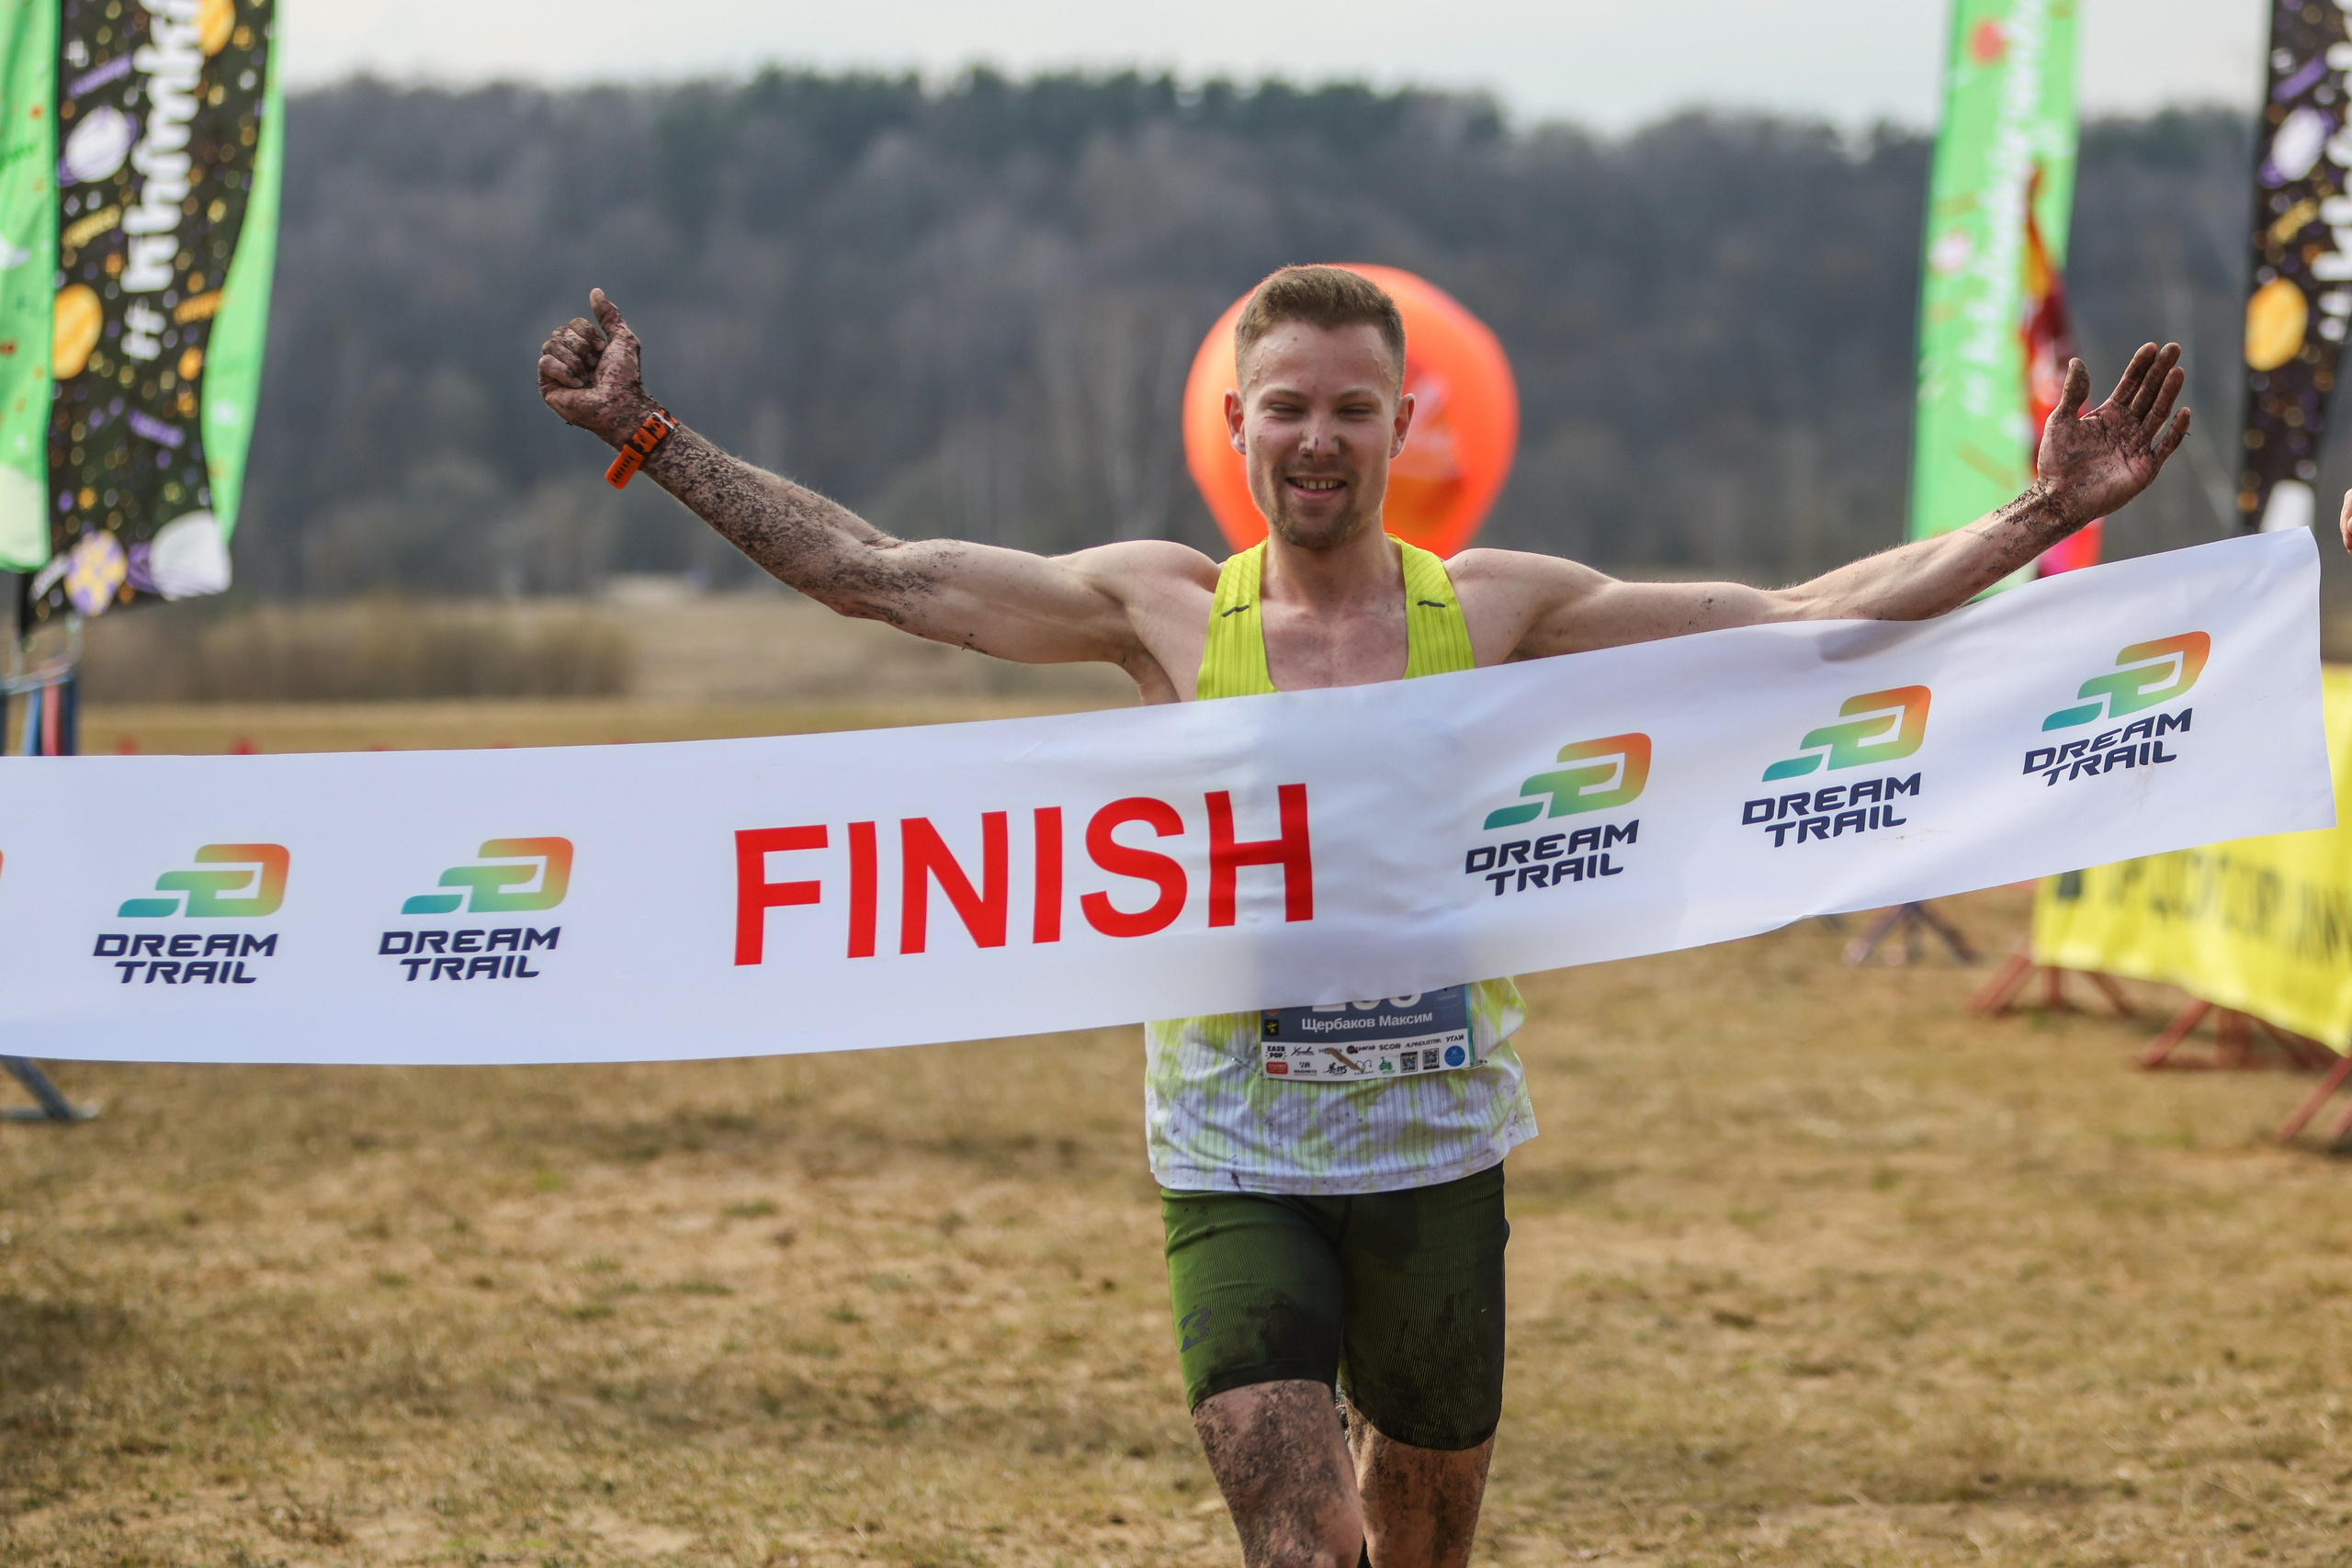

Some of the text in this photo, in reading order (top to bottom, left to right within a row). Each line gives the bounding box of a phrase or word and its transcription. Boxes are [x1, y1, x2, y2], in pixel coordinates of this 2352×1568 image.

[2022, 708, 2193, 774] DREAM
[2042, 741, 2177, 786] TRAIL
[1742, 773, 1921, 825] DREAM
[1465, 819, 1639, 874] DREAM
[1765, 805, 1906, 848] TRAIL
[734, 783, 1314, 966] FINISH
[1486, 852, 1623, 896] TRAIL
[93, 933, 278, 957] DREAM
[379, 926, 561, 955] DREAM
[114, 961, 257, 984] TRAIL
[400, 954, 540, 981] TRAIL
[1302, 1012, 1433, 1033] Щербаков Максим
